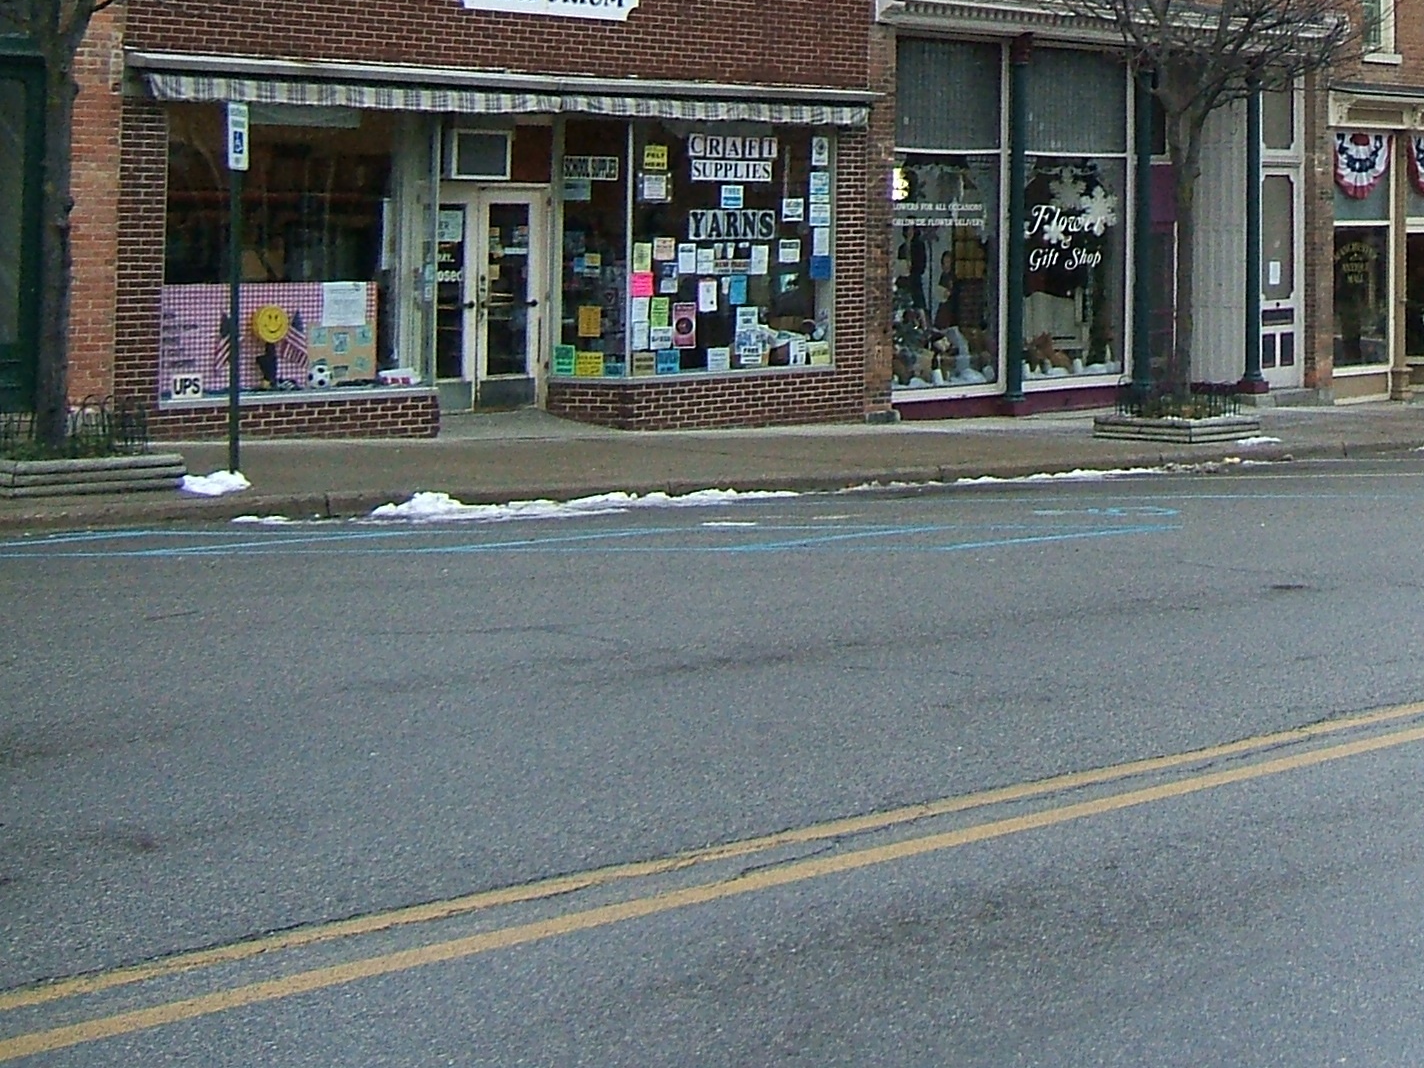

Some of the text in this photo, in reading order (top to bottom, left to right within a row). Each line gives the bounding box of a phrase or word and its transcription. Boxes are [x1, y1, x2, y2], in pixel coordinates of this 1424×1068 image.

[690, 135, 777, 157] CRAFT
[692, 161, 771, 180] SUPPLIES
[892, 202, 919, 211] LOWERS
[920, 203, 933, 211] FOR
[935, 203, 946, 211] ALL
[690, 210, 774, 239] YARNS
[892, 217, 927, 226] ORLDWIDE
[1026, 204, 1106, 235] Flower
[1060, 236, 1073, 249] &
[1029, 247, 1102, 272] Gift Shop
[173, 378, 201, 395] UPS
